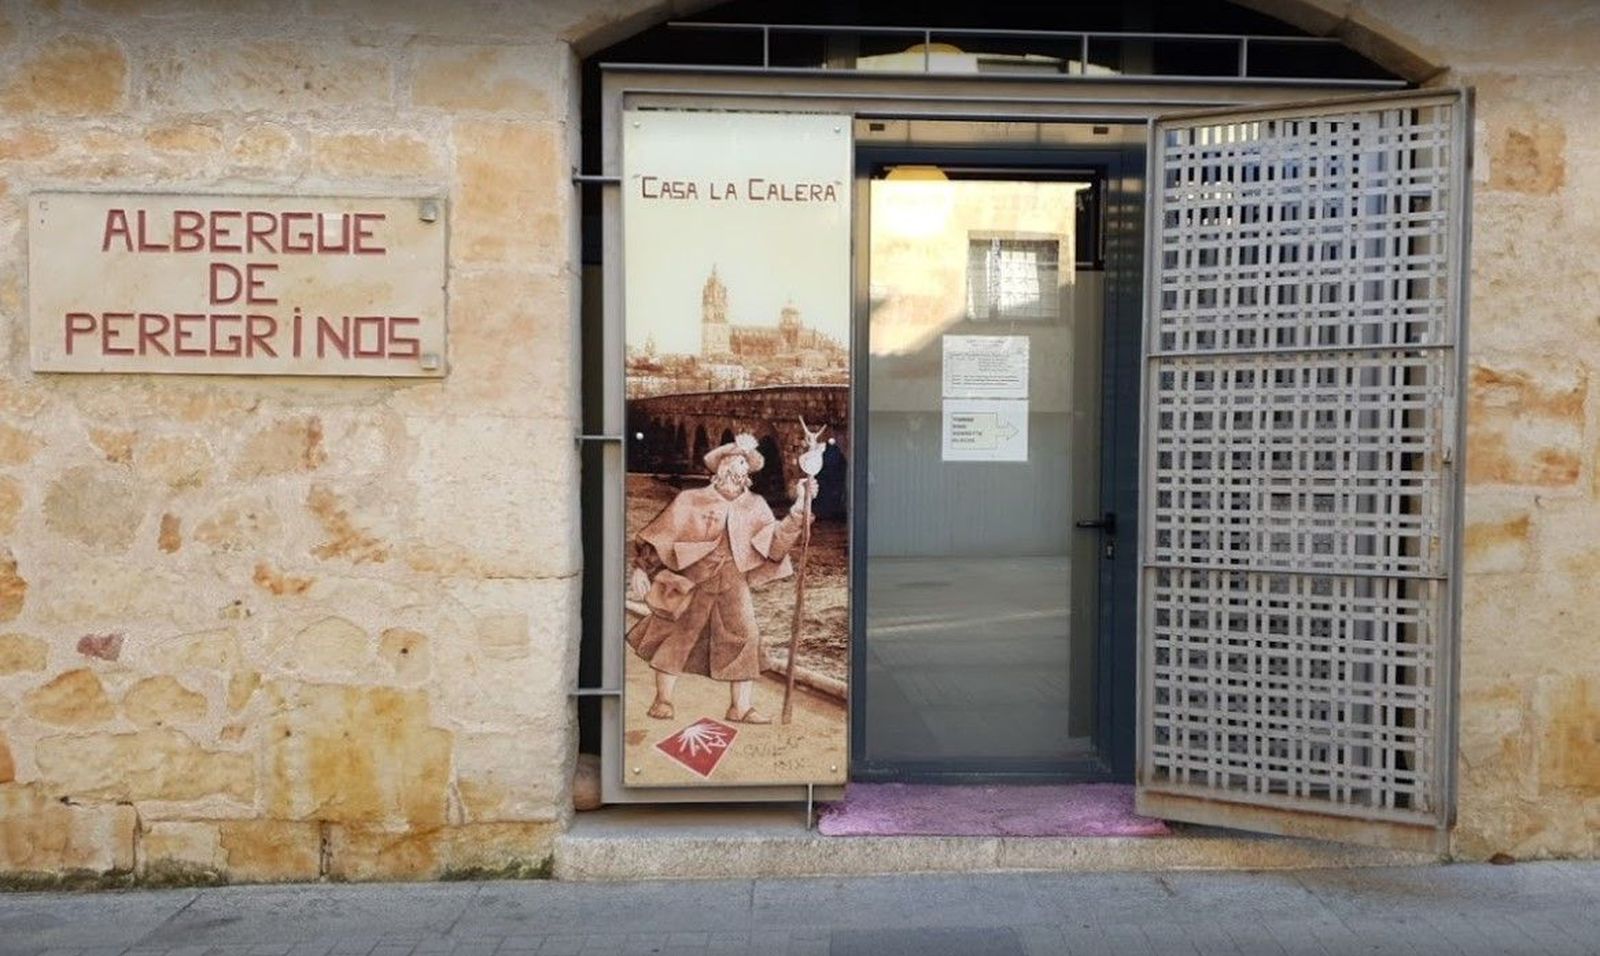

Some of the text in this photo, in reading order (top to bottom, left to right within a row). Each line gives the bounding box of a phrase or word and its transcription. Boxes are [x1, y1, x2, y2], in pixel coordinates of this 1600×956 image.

[710, 182, 738, 201] LA
[103, 209, 387, 255] ALBERGUE
[209, 263, 279, 306] DE
